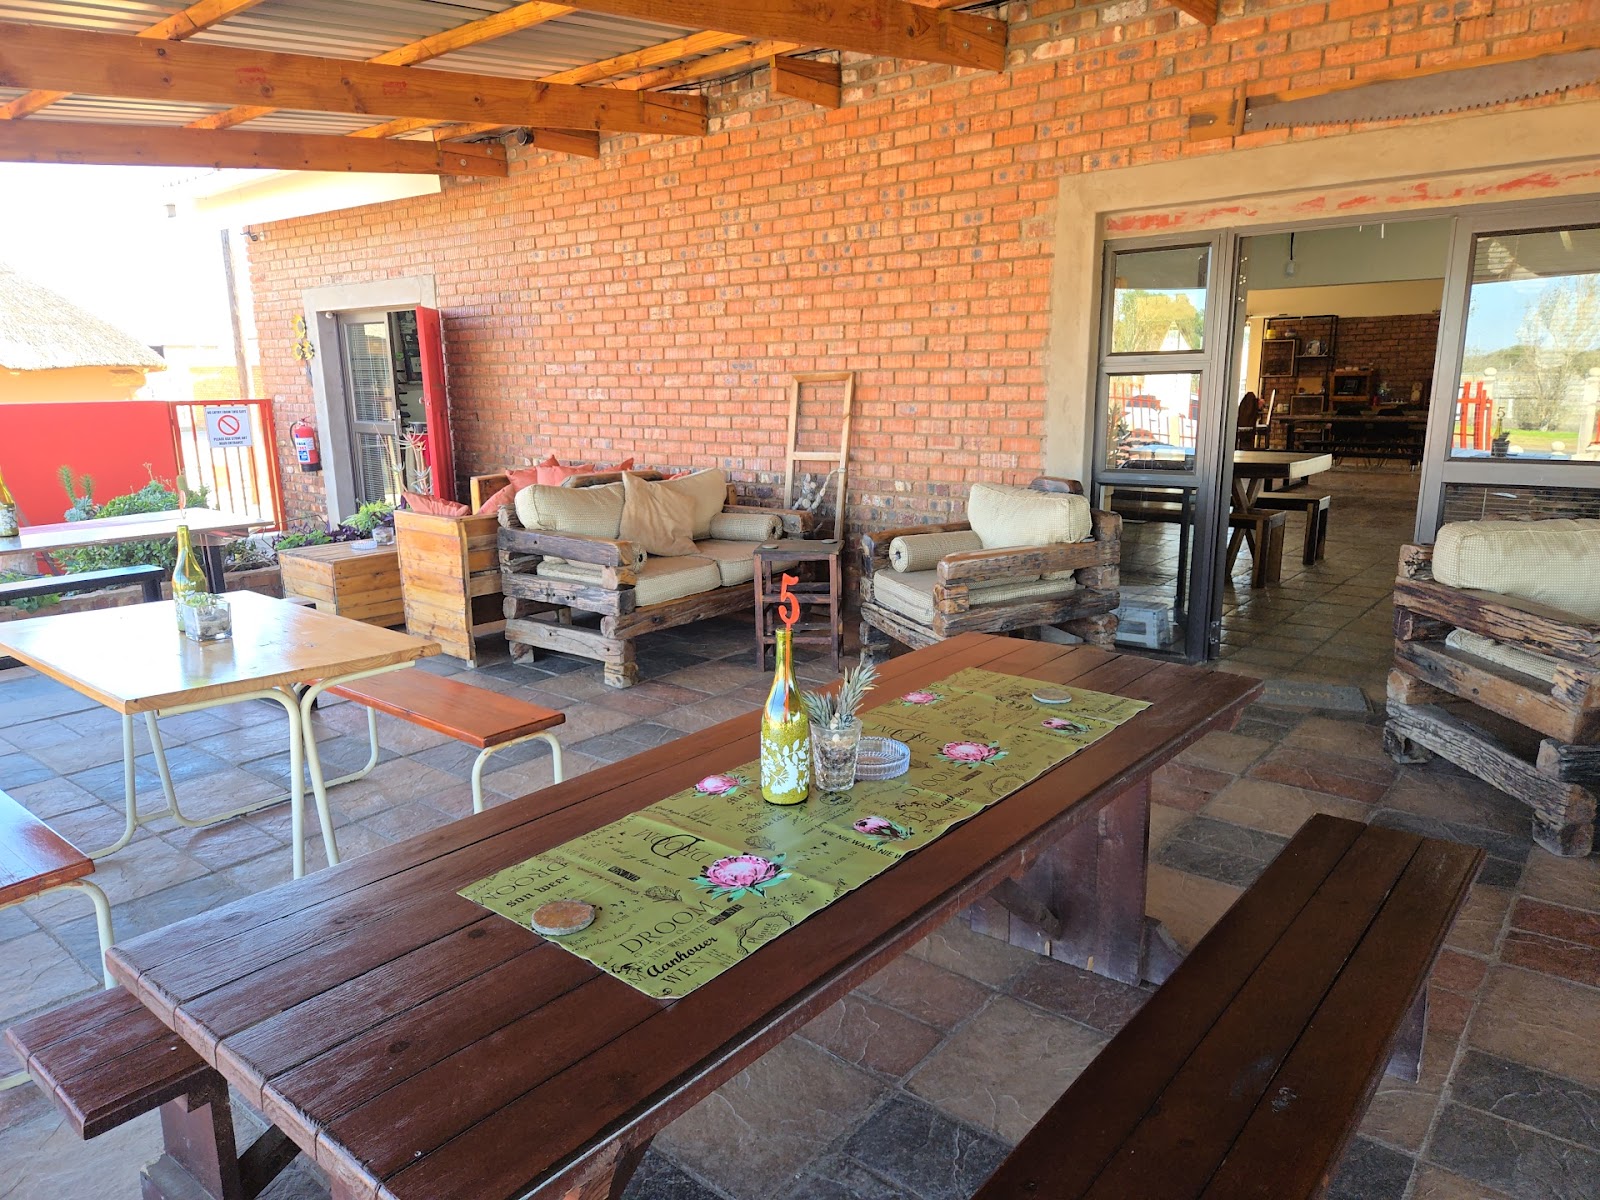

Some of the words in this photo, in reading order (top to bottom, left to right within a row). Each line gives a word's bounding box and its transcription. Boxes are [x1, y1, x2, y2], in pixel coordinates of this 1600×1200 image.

[778, 573, 800, 625] 5
[877, 847, 894, 857] NIE
[506, 891, 536, 907] son
[534, 874, 571, 893] weer
[617, 900, 717, 953] DROOM
[692, 923, 711, 937] NIE
[646, 936, 719, 978] Aanhouer
[660, 956, 712, 986] WEN
